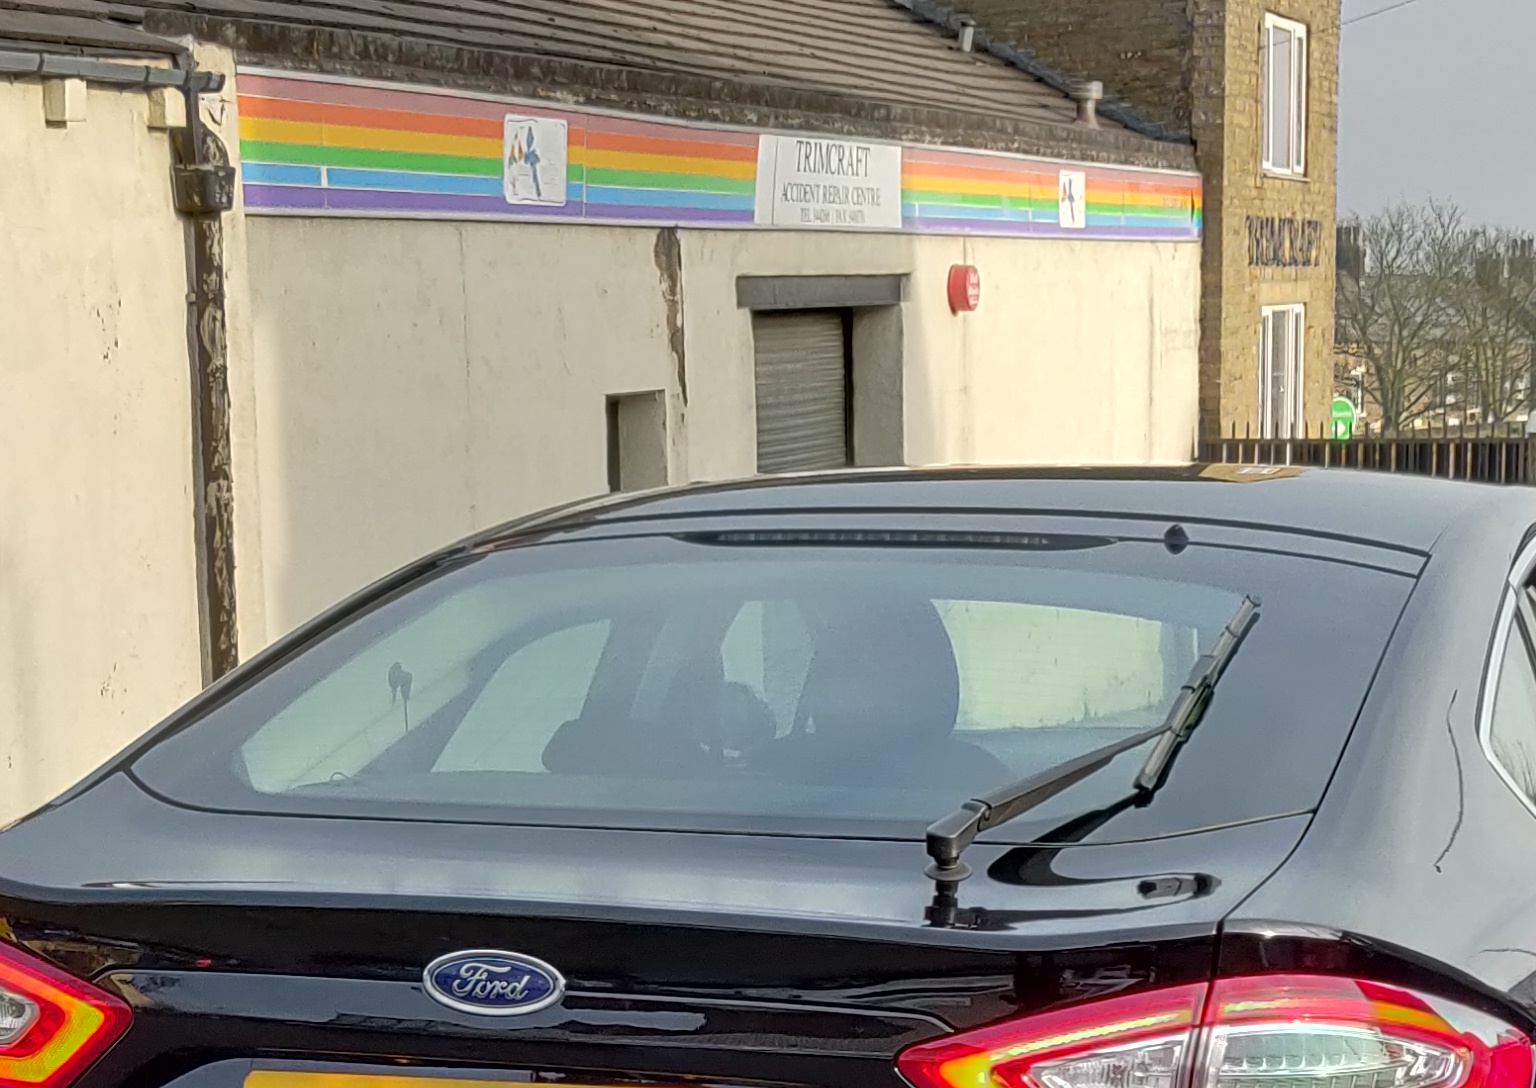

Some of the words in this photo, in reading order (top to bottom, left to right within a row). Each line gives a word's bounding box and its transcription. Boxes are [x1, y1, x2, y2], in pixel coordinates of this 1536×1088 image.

[796, 140, 871, 178] TRIMCRAFT
[780, 182, 821, 204] ACCIDENT
[822, 185, 850, 206] REPAIR
[851, 186, 881, 207] CENTRE
[451, 962, 531, 1000] Ford
